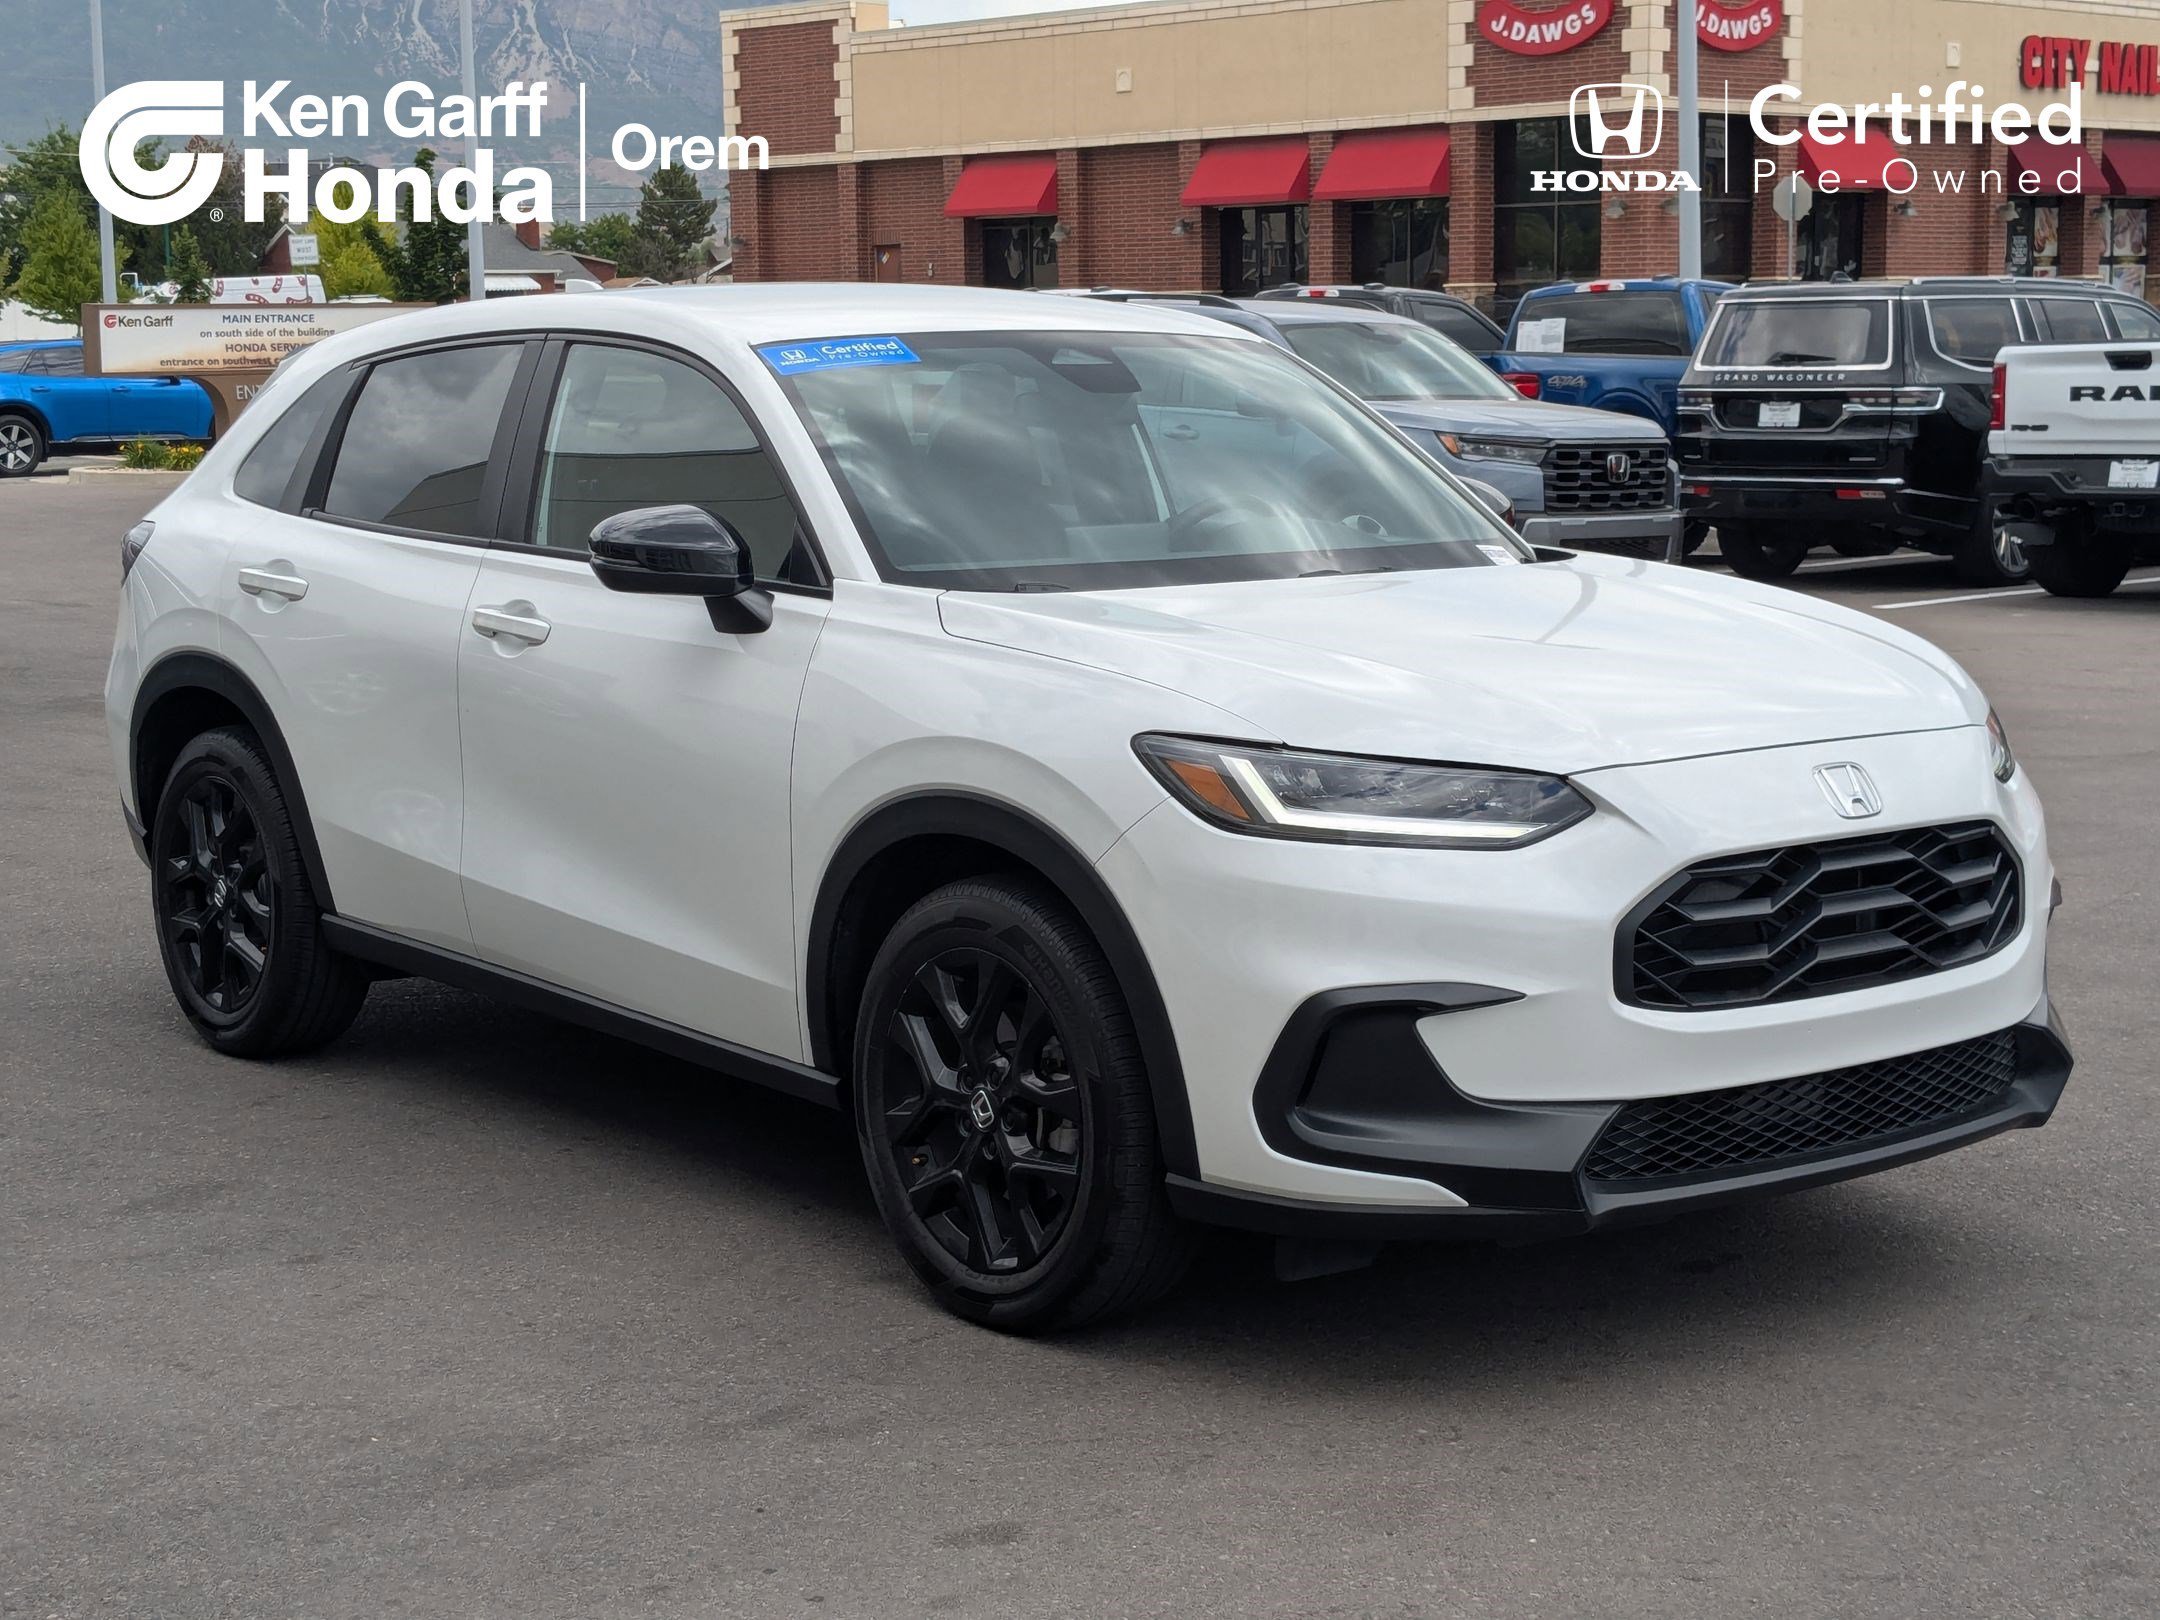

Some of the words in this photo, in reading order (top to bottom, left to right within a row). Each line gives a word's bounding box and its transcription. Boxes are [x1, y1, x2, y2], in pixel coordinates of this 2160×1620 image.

[1490, 3, 1597, 44] J.DAWGS
[2021, 35, 2091, 91] CITY
[118, 316, 141, 327] Ken
[144, 315, 173, 327] Garff
[222, 314, 251, 323] MAIN
[255, 314, 315, 323] ENTRANCE
[215, 328, 242, 338] south
[245, 328, 264, 338] side
[266, 328, 277, 338] of
[278, 328, 295, 338] the
[297, 328, 335, 338] building
[225, 343, 267, 353] HONDA
[822, 341, 899, 355] Certified
[829, 350, 905, 360] Pre-Owned
[160, 358, 204, 367] entrance
[207, 359, 220, 367] on
[222, 357, 272, 367] southwest
[780, 357, 820, 366] HONDA
[2069, 386, 2160, 402] RA
